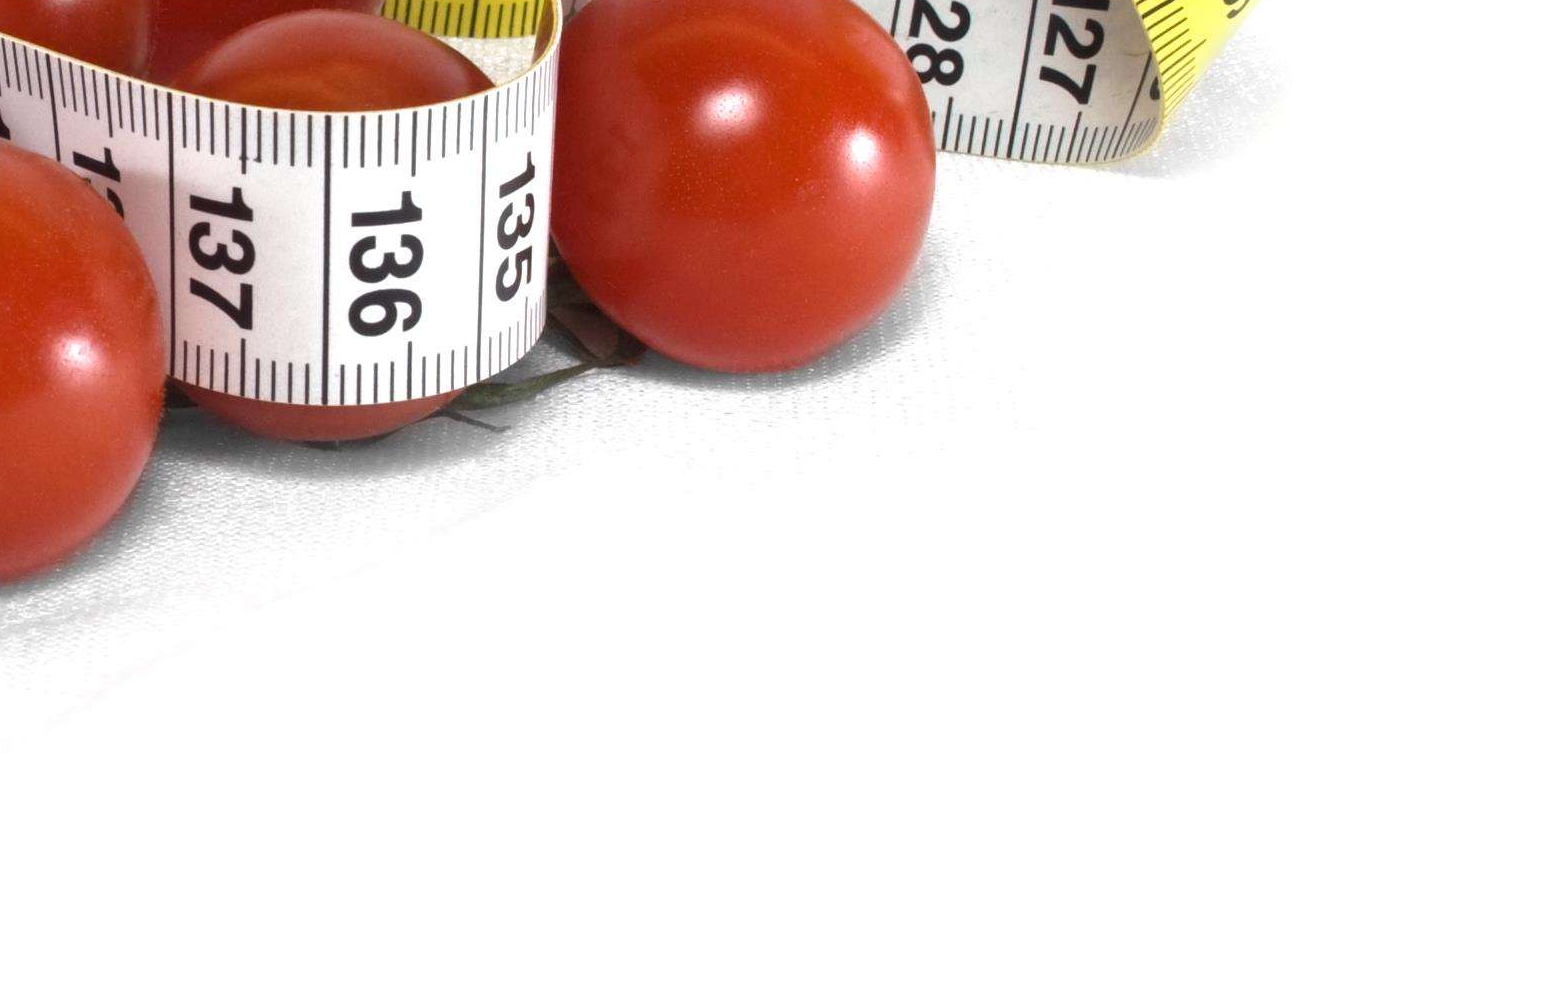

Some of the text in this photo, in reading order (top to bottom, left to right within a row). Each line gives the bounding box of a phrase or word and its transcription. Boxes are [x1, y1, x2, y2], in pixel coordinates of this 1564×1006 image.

[187, 185, 257, 332] 137
[347, 190, 425, 338] 136
[494, 150, 536, 303] 135
